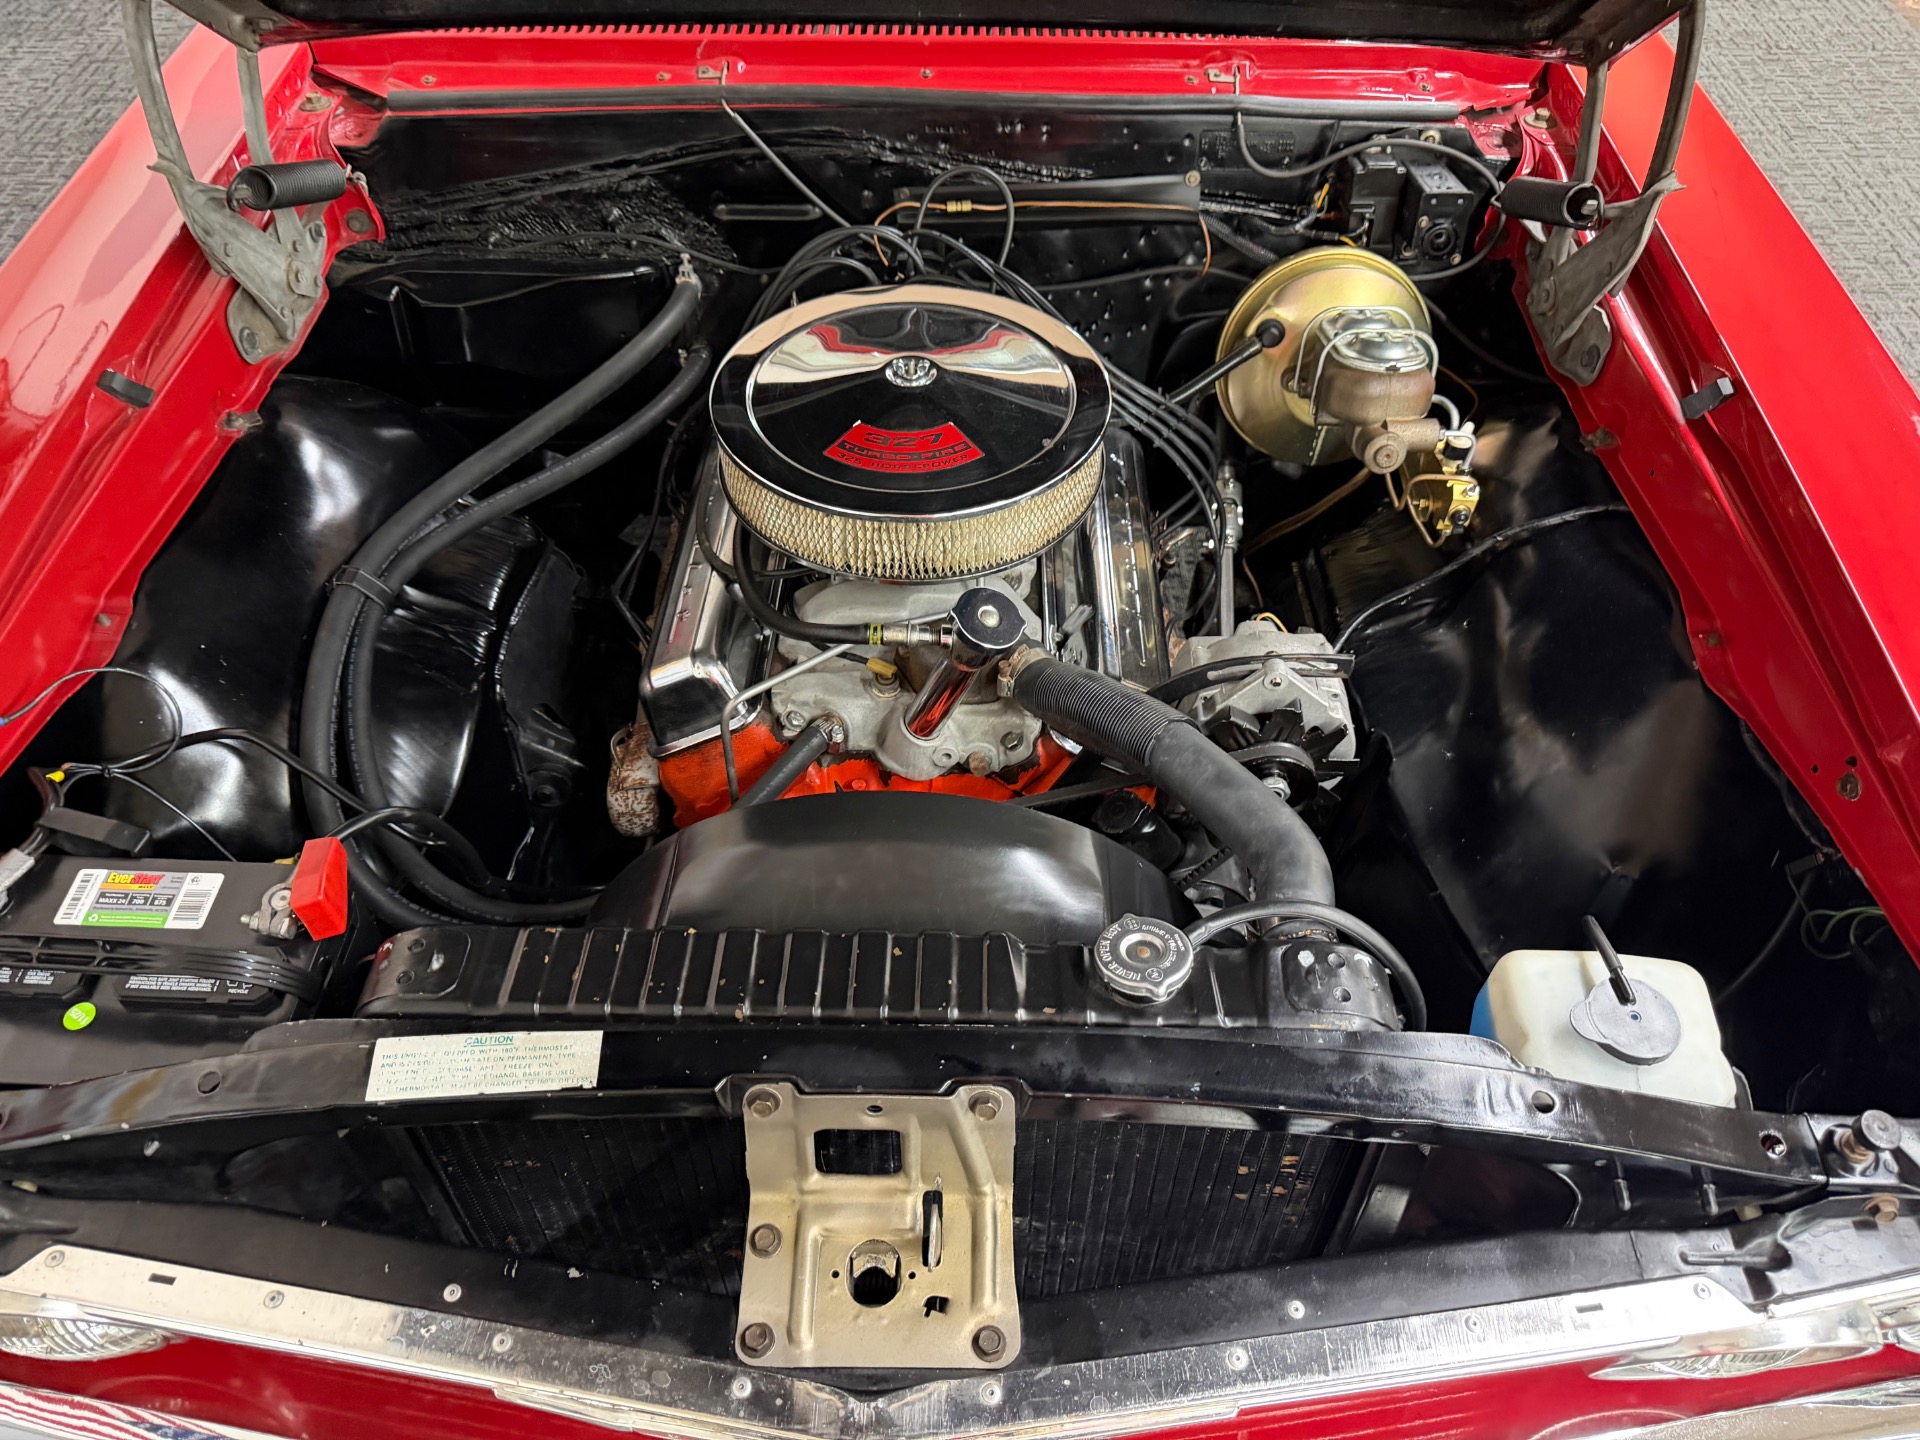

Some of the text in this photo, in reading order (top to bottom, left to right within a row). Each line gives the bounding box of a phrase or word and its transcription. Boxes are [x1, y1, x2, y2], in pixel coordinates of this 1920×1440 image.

[863, 432, 943, 448] 327
[837, 453, 969, 470] 325 HORSEPOWER
[107, 871, 164, 885] EverStart
[1099, 923, 1141, 981] NEVER OPEN HOT
[464, 1035, 513, 1045] CAUTION
[524, 1044, 573, 1052] THERMOSTAT
[507, 1053, 553, 1061] PERMANENT
